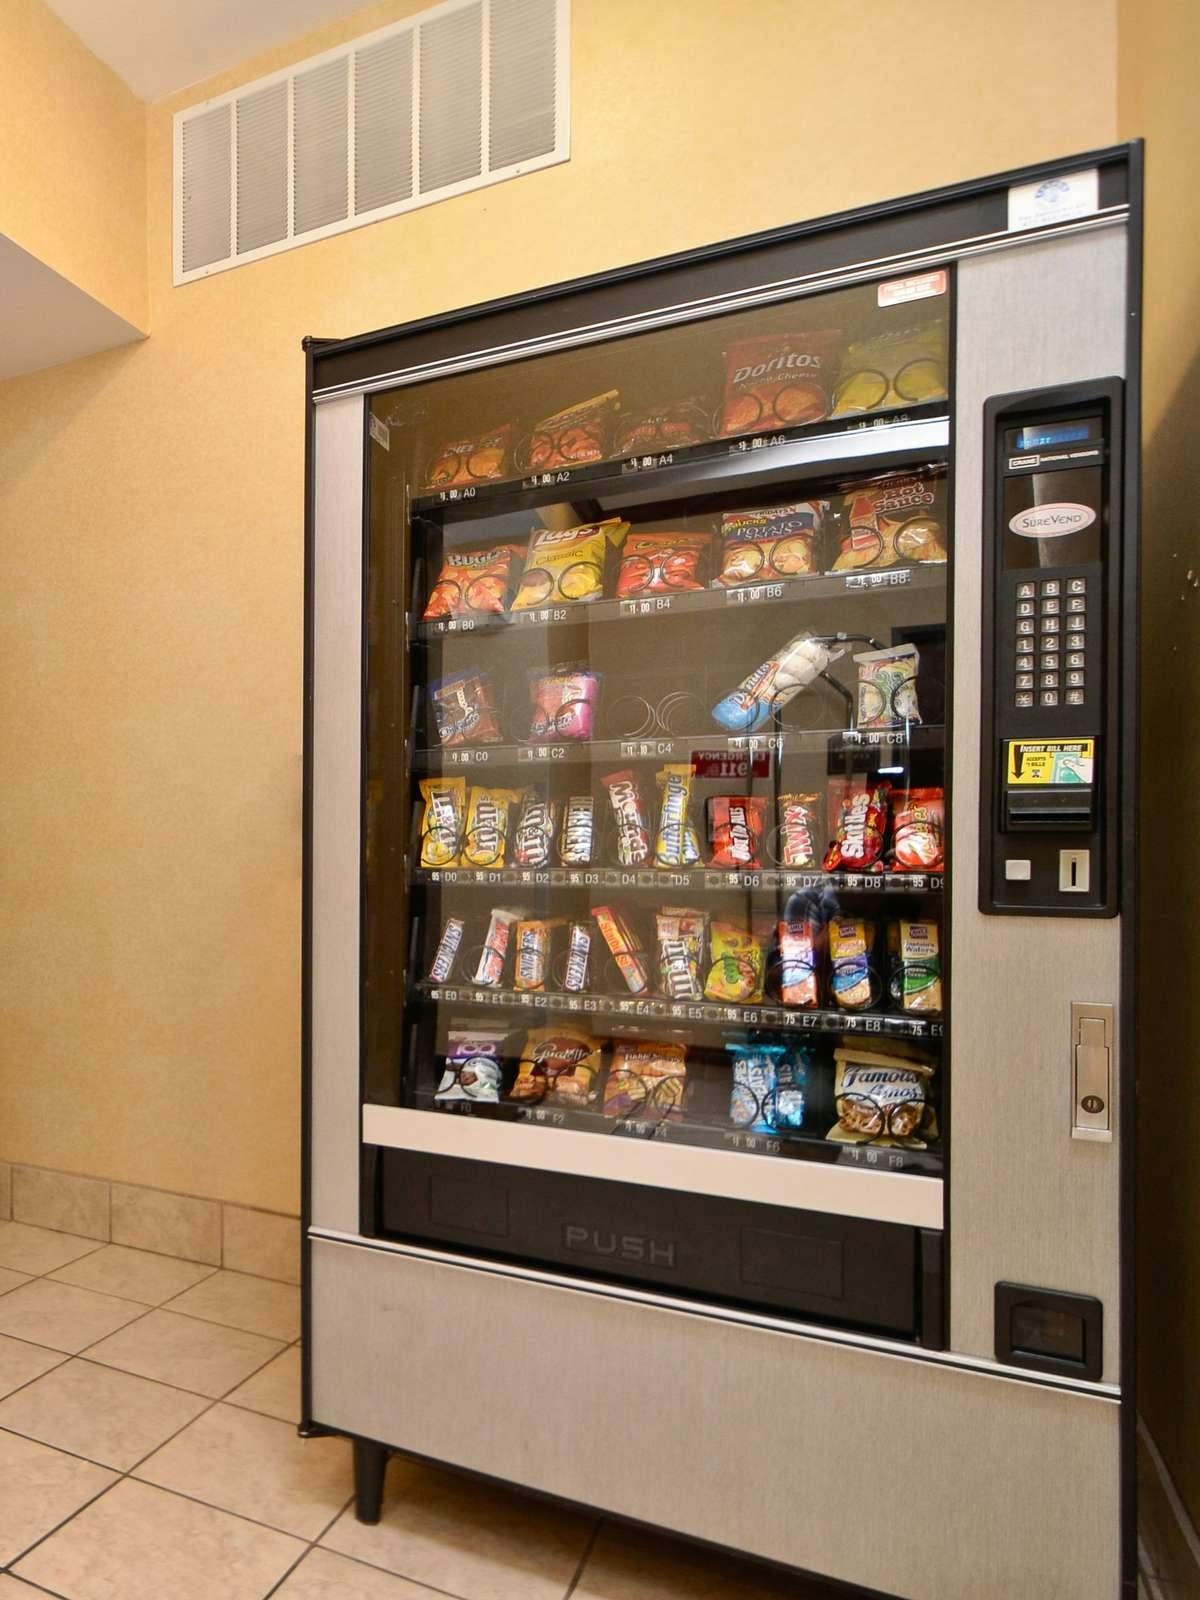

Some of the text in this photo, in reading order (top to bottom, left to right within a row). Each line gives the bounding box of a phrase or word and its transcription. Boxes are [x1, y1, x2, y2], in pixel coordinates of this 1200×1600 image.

[733, 353, 820, 383] Doritos
[659, 453, 673, 464] A4
[556, 471, 570, 482] A2
[463, 487, 476, 497] A0
[884, 482, 925, 498] Hot
[873, 492, 935, 514] Sauce
[766, 587, 783, 598] B6
[656, 598, 671, 609] B4
[553, 609, 567, 620] B2
[886, 733, 904, 744] C8
[551, 748, 565, 758] C2
[657, 744, 672, 753] C4
[1063, 744, 1083, 752] HERE
[444, 871, 457, 881] D0
[489, 873, 501, 882] D1
[536, 873, 549, 883] D2
[585, 873, 599, 883] D3
[622, 874, 636, 885] D4
[675, 874, 690, 886] D5
[744, 875, 760, 886] D6
[803, 875, 818, 887] D7
[864, 877, 881, 888] D8
[534, 998, 547, 1007] E2
[584, 1000, 597, 1010] E3
[636, 1003, 649, 1014] E4
[688, 1007, 701, 1018] E5
[743, 1012, 758, 1023] E6
[802, 1016, 817, 1027] E7
[865, 1020, 881, 1032] E8
[456, 1043, 496, 1056] 100
[841, 1065, 920, 1089] Famous
[566, 1225, 676, 1267] PUSH
